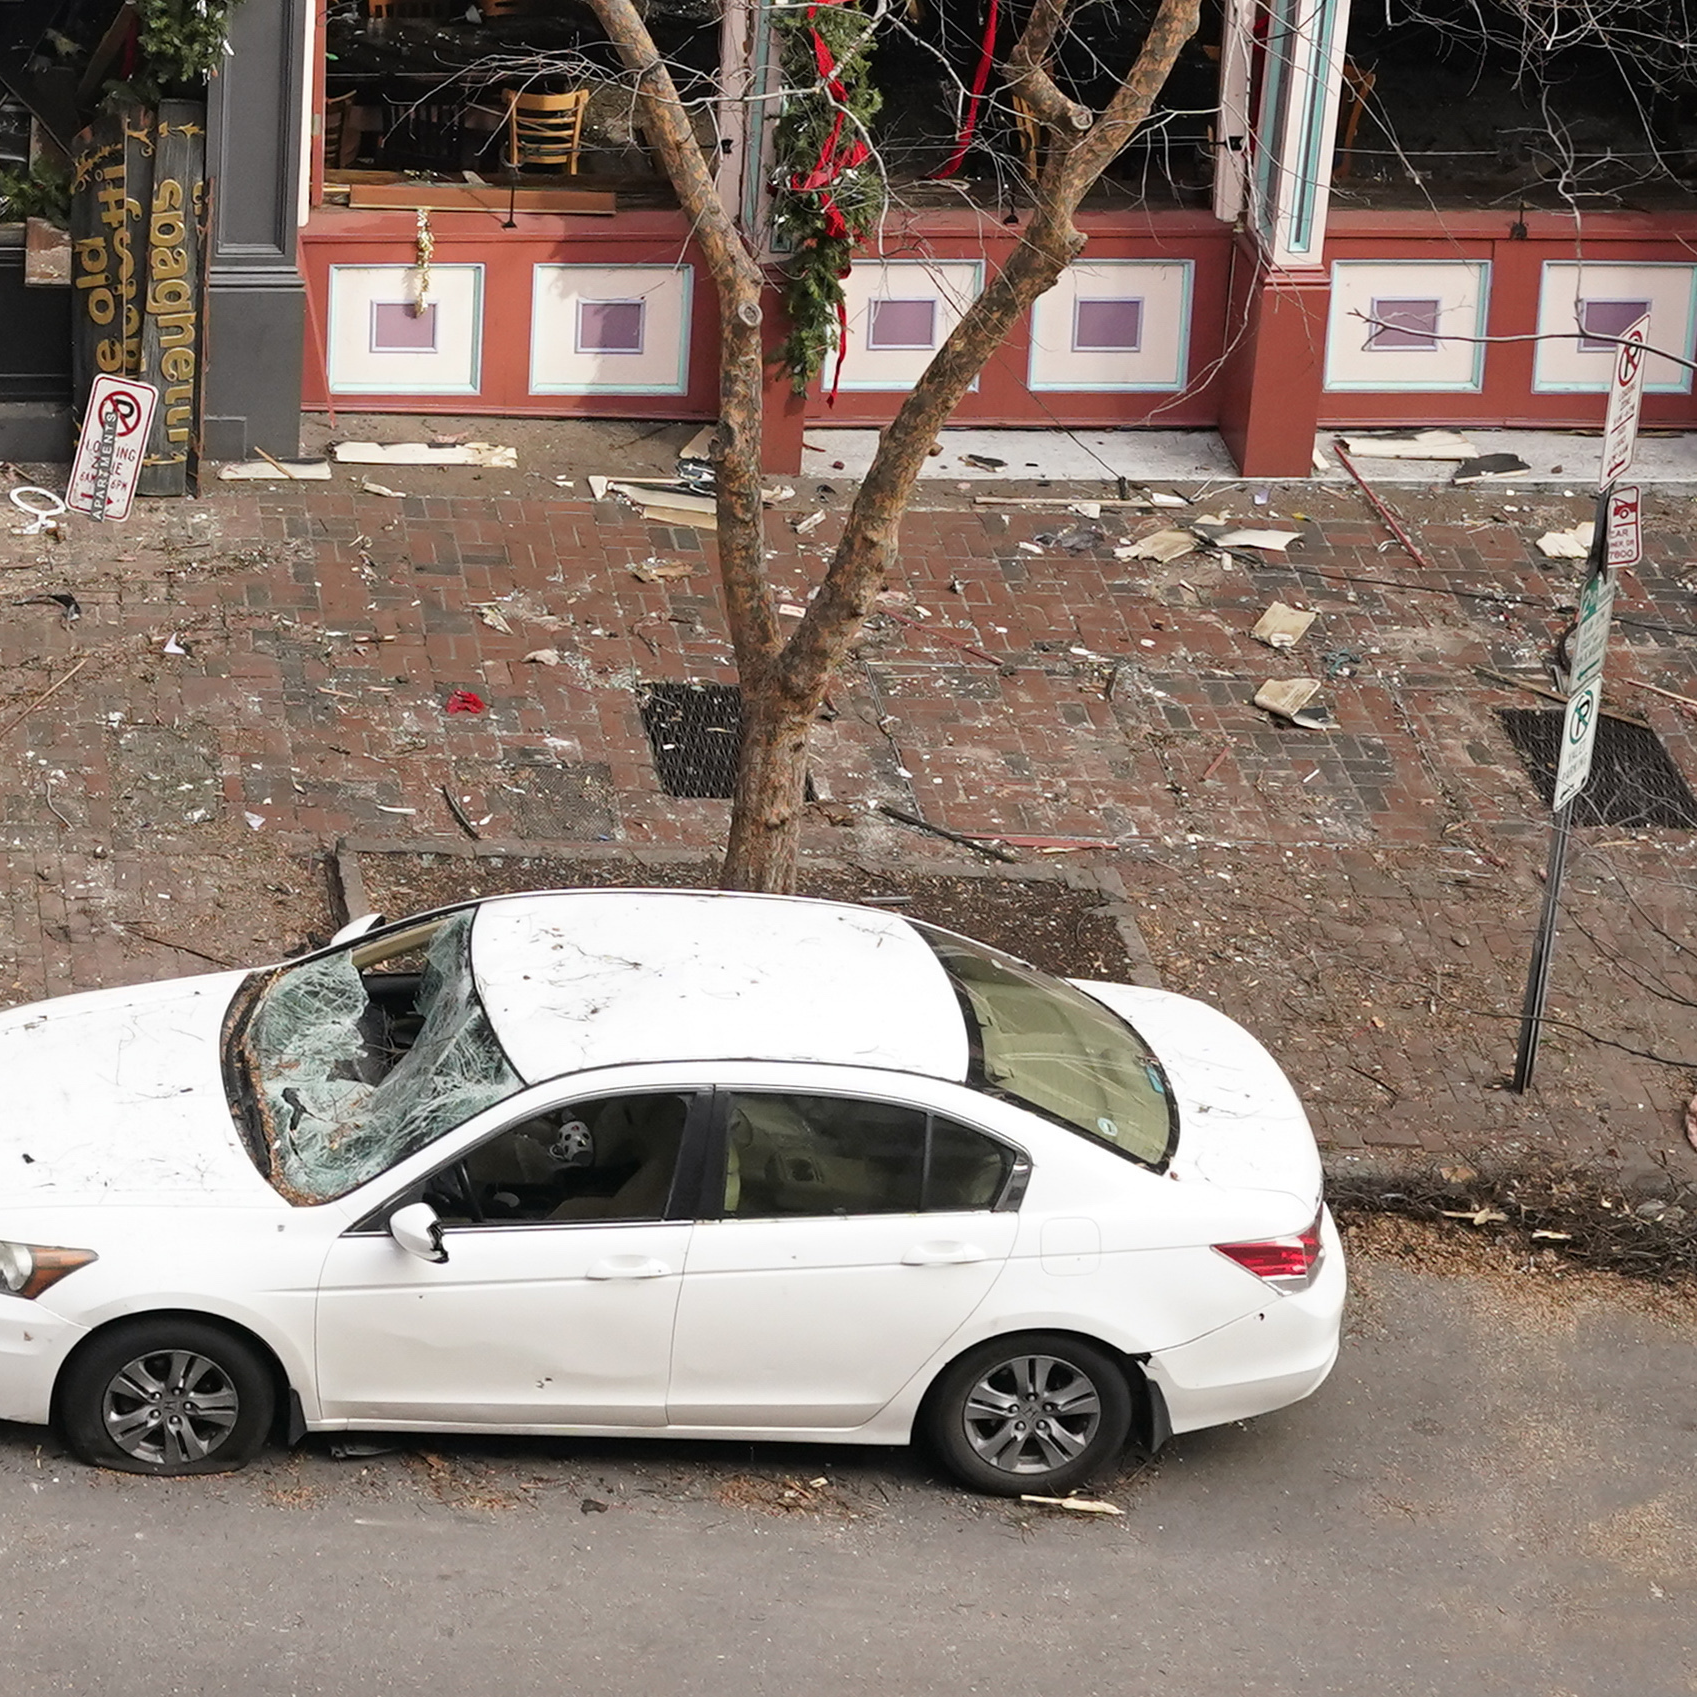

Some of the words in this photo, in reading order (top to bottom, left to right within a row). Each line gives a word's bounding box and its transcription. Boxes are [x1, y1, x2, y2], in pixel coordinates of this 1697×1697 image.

[74, 236, 117, 325] old
[85, 439, 137, 462] LOING
[92, 412, 117, 521] APARTMENTS
